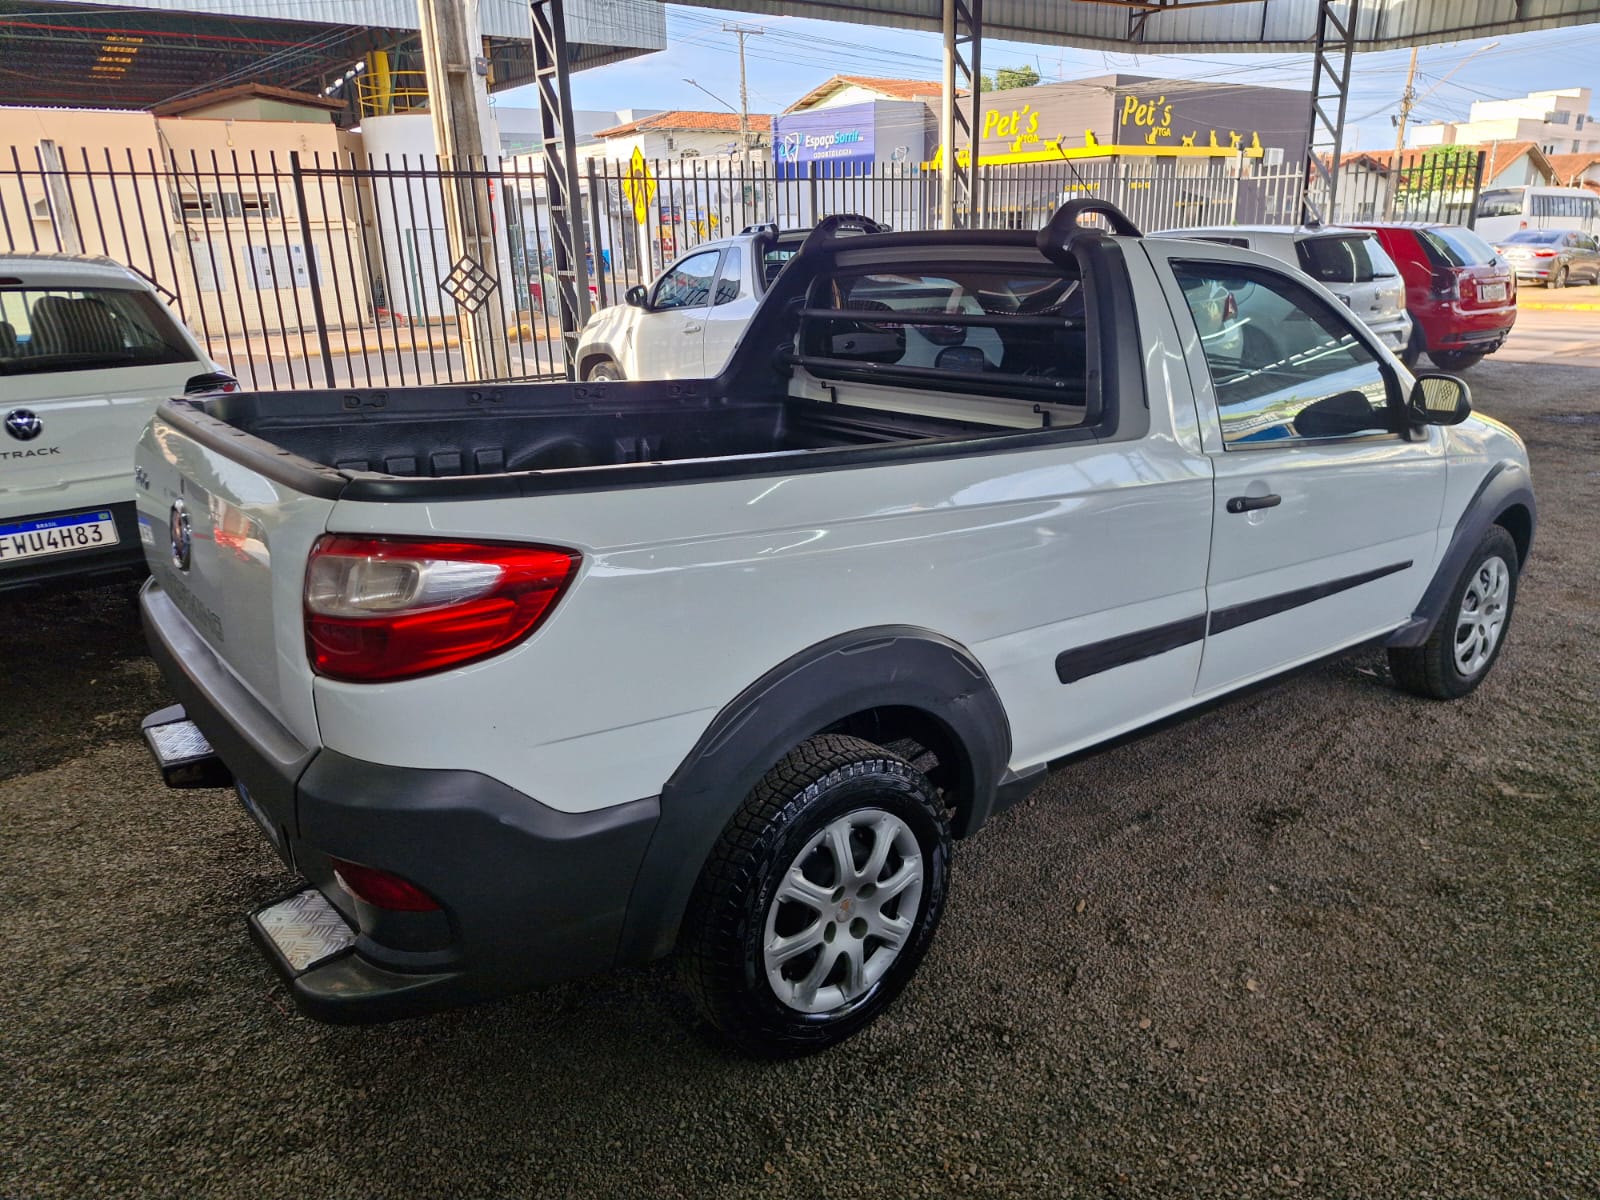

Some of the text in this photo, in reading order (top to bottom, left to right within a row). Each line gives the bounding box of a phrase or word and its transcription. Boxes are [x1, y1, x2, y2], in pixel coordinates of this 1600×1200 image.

[983, 104, 1041, 139] Pet's
[1122, 95, 1172, 126] Pet's
[0, 446, 61, 460] TRACK
[0, 524, 103, 557] FWU4H83
